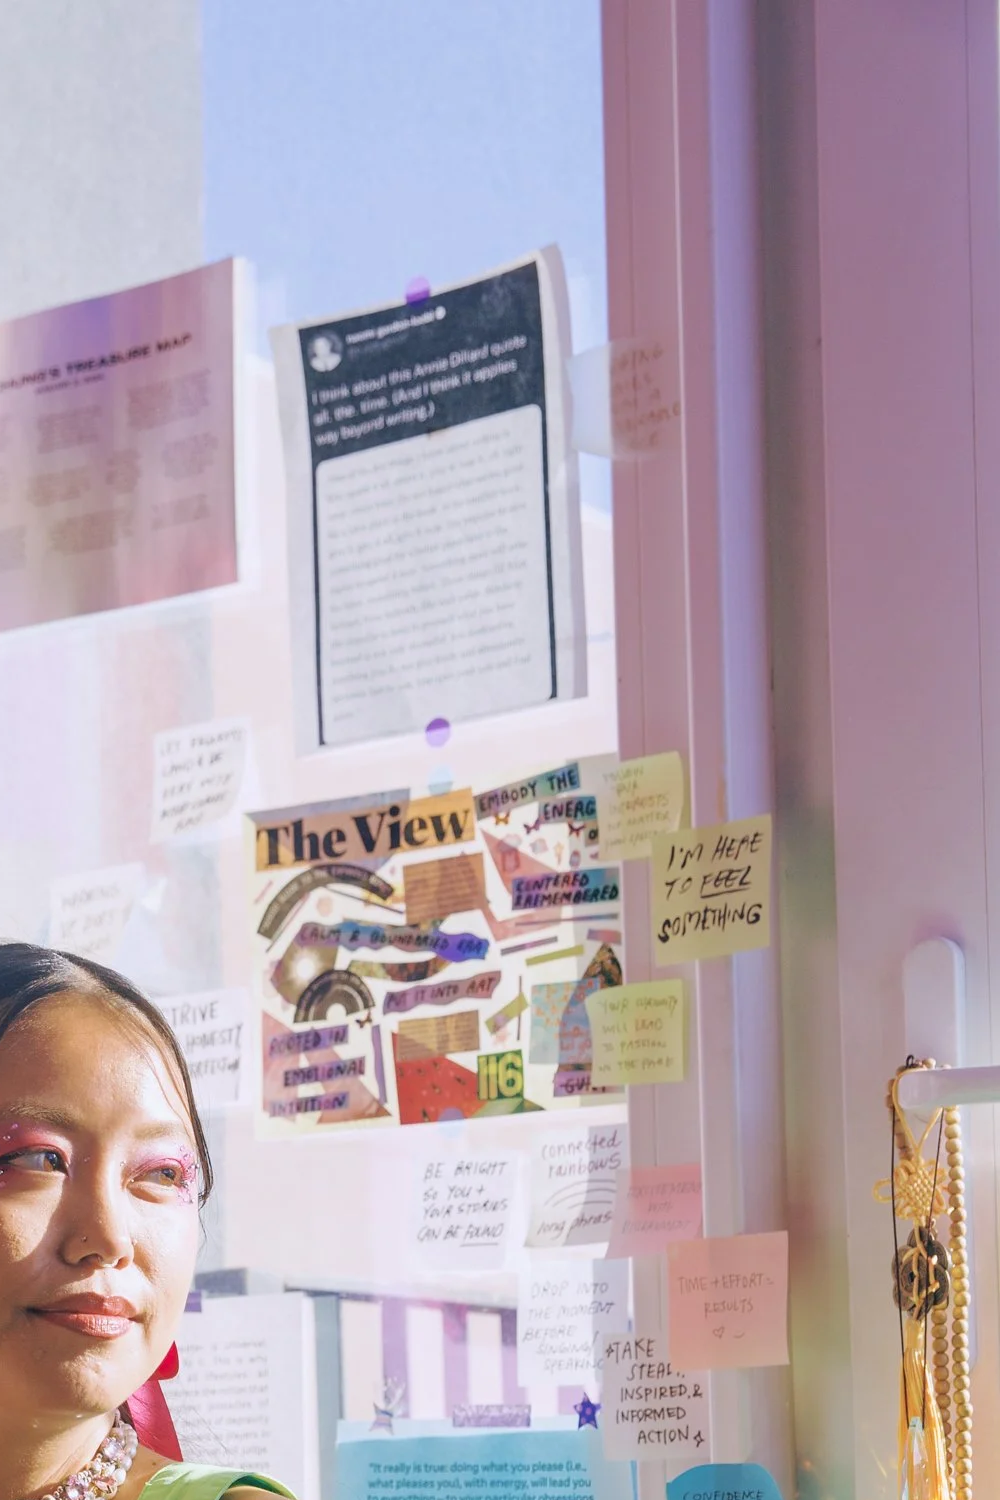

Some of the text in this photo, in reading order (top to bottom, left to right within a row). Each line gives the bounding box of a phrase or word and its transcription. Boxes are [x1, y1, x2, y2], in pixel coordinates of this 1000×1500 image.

[66, 344, 152, 373] TREASURE
[319, 384, 350, 404] think
[352, 375, 387, 396] about
[388, 368, 412, 384] this
[413, 356, 449, 379] Annie
[490, 334, 528, 358] quote
[430, 374, 461, 395] think
[473, 358, 518, 383] applies
[313, 430, 340, 447] way
[340, 417, 385, 440] beyond
[479, 769, 578, 812] EMBODY THE
[257, 806, 470, 866] The View
[516, 874, 590, 893] CENTERED
[665, 866, 752, 902] TO FEEL
[658, 903, 763, 944] SOMETHING
[541, 1130, 623, 1160] connected
[424, 1161, 508, 1182] BE BRIGHT
[548, 1153, 622, 1179] rainbows
[446, 1184, 471, 1200] YOU
[423, 1199, 509, 1221] YOUR STORIES
[416, 1222, 506, 1243] CAN BE FOUND
[530, 1281, 610, 1300] DROP INTO
[678, 1271, 763, 1295] TIME EFFORT
[528, 1301, 616, 1320] THE MOMENT
[704, 1298, 754, 1320] RESULTS
[523, 1325, 577, 1344] BEFORE
[612, 1338, 656, 1364] TAKE
[616, 1406, 686, 1425] INFORMED
[638, 1425, 690, 1445] ACTION
[384, 1461, 564, 1475] really doing what you please
[368, 1477, 592, 1490] what pleases with will lead you
